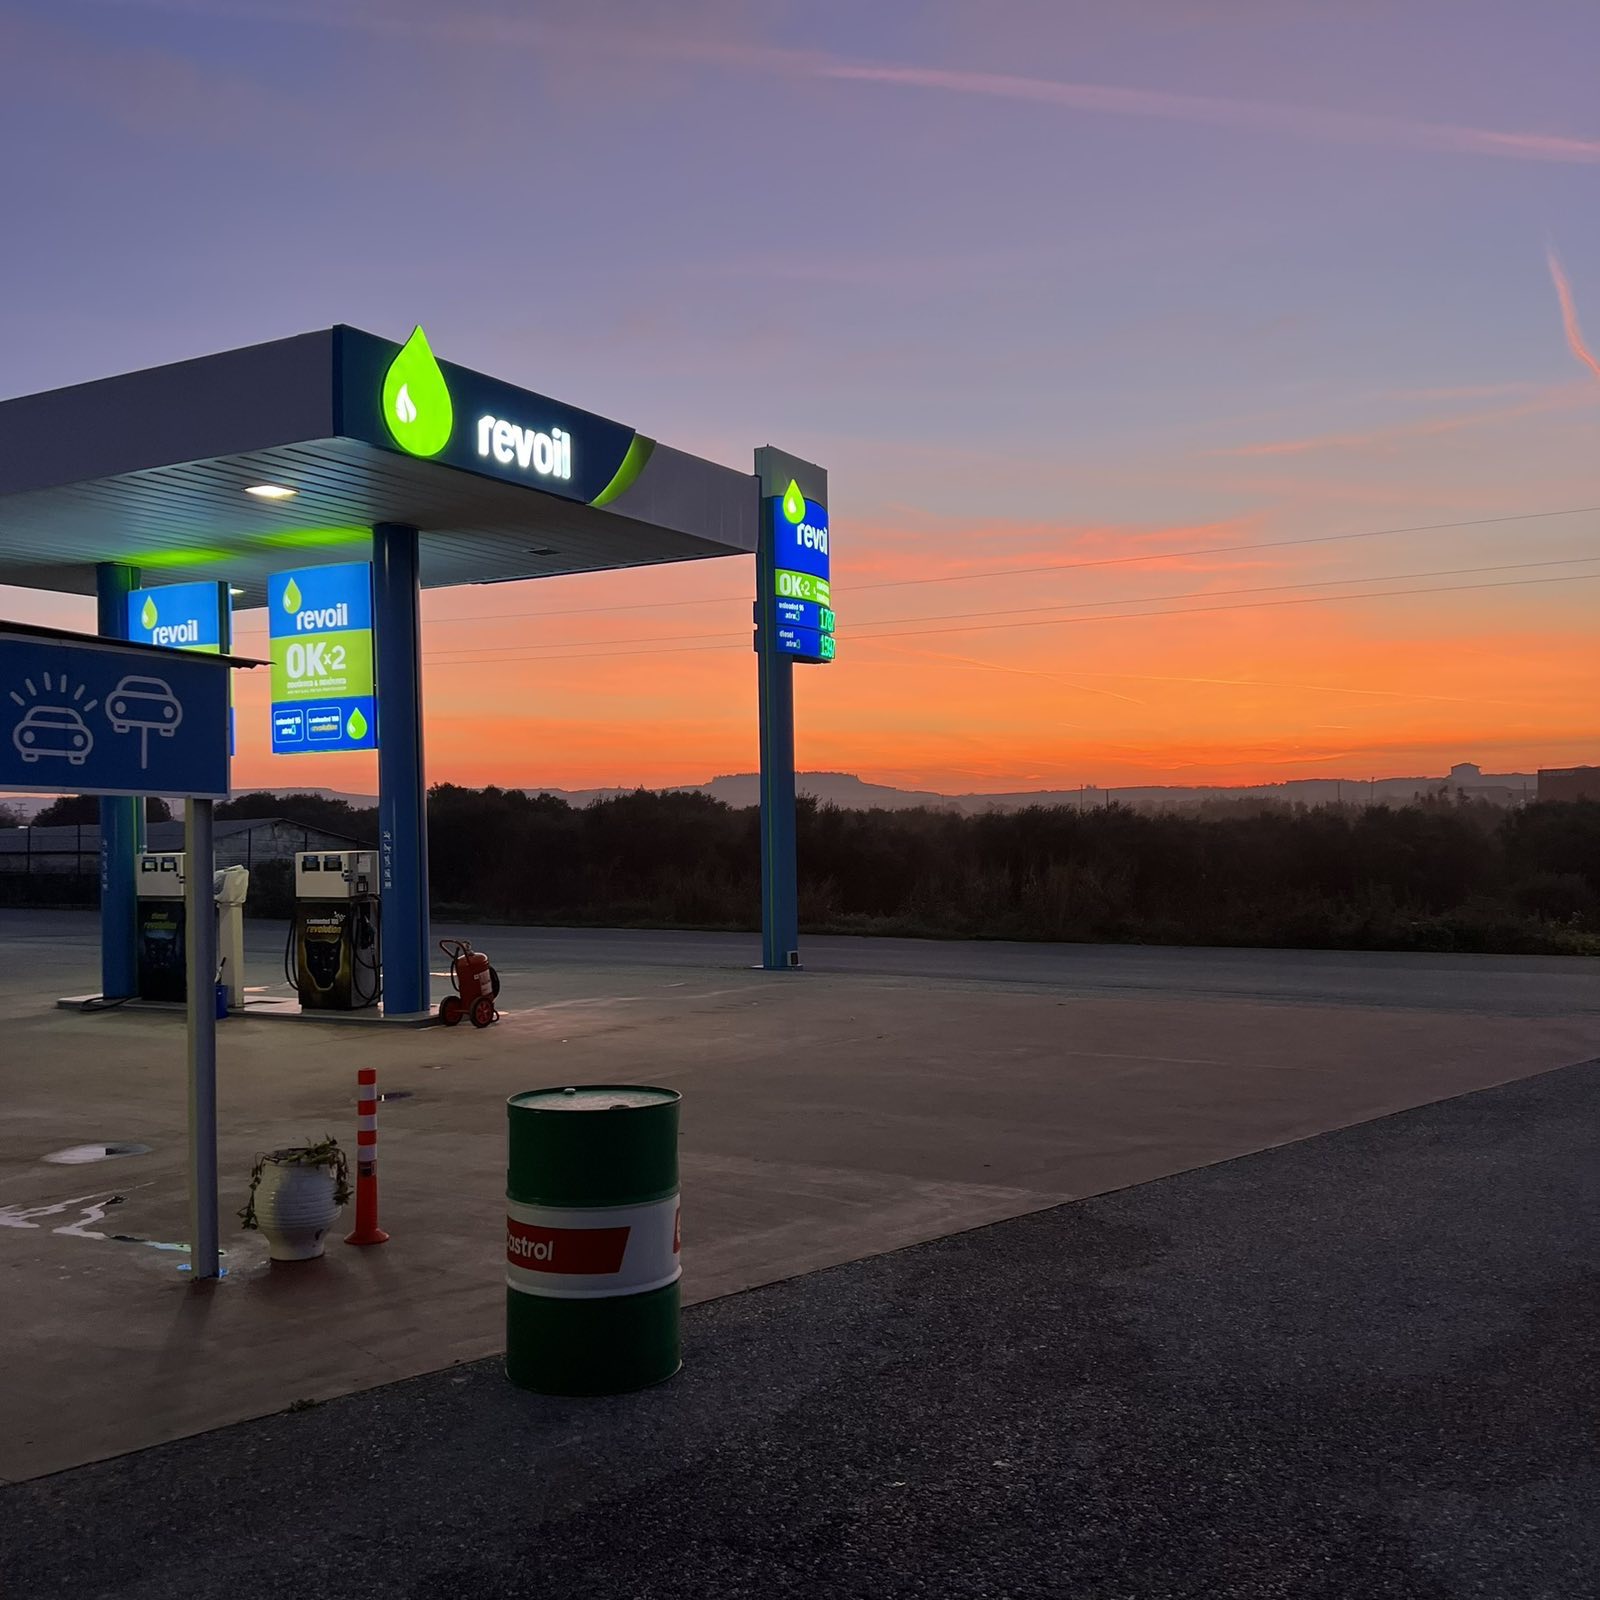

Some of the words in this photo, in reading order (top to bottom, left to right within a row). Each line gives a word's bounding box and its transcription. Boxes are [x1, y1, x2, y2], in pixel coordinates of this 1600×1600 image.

[478, 415, 571, 480] revoil
[296, 602, 348, 631] revoil
[152, 619, 198, 645] revoil
[306, 924, 342, 934] revolution
[507, 1232, 554, 1262] astrol
